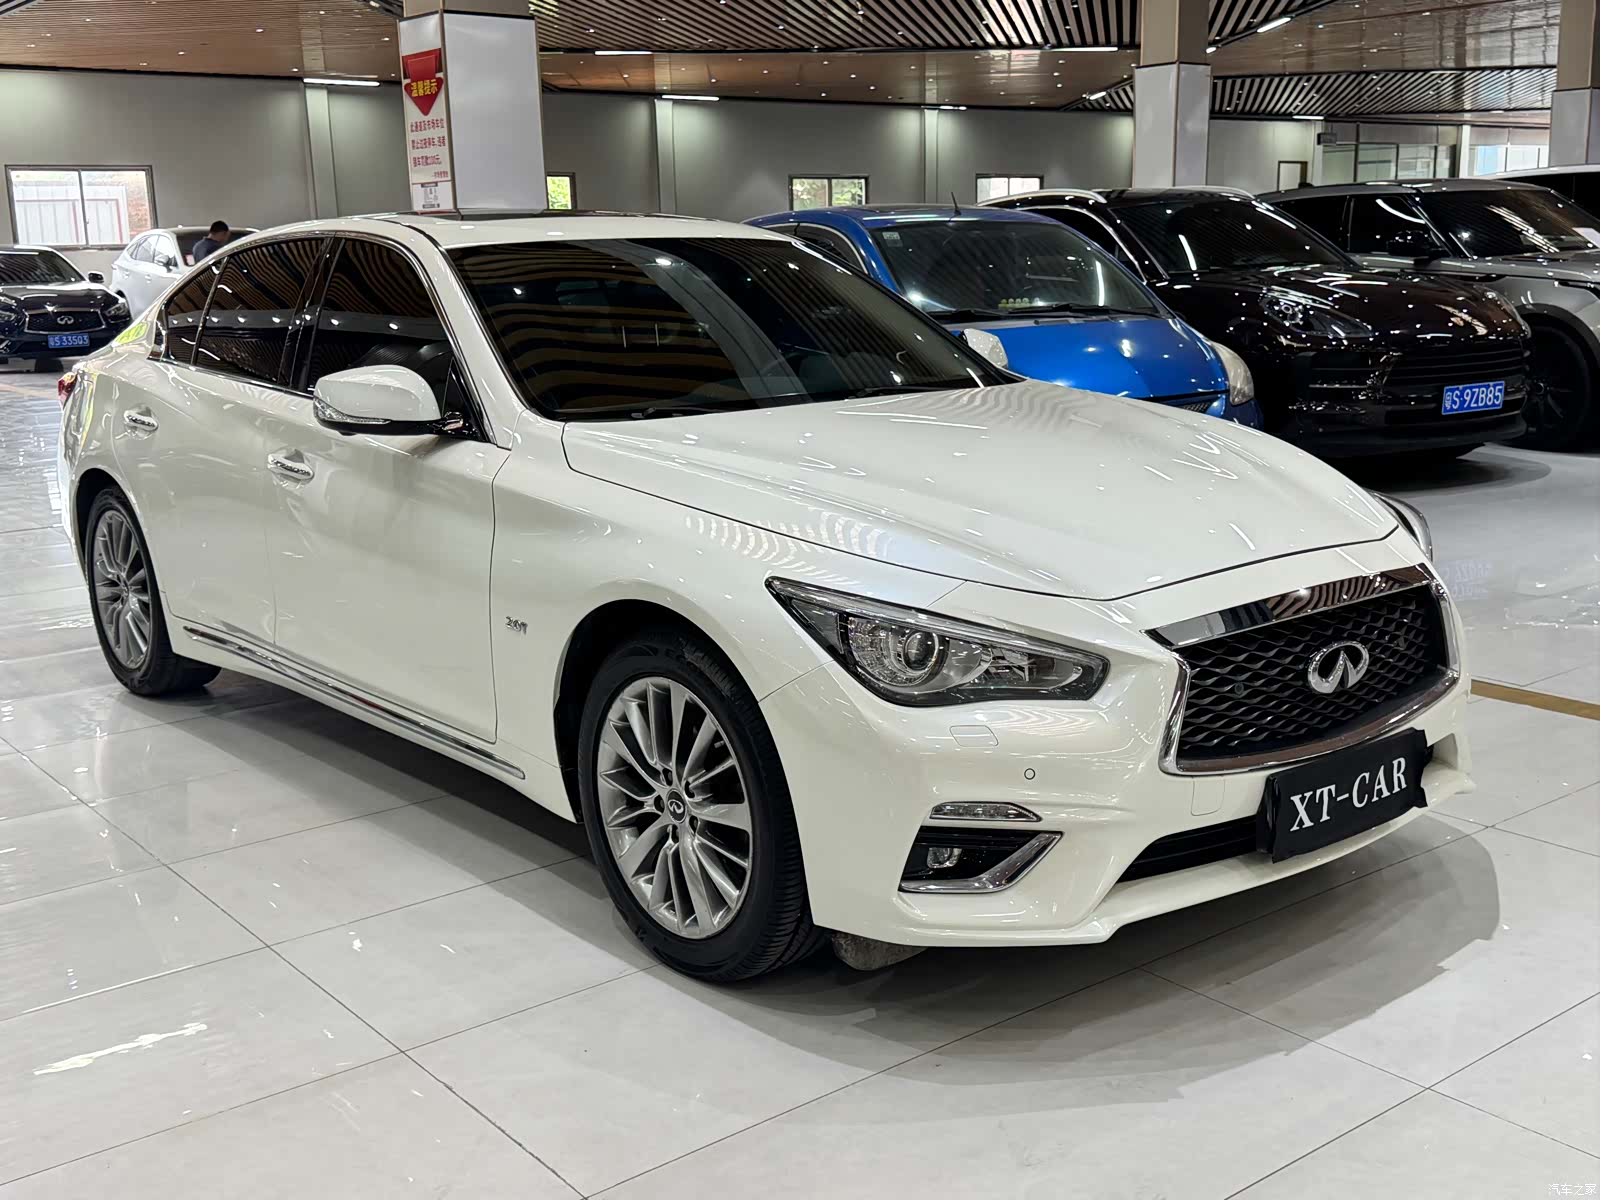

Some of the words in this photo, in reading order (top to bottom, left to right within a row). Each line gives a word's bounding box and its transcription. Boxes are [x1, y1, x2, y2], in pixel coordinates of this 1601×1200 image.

[411, 79, 438, 97] 温馨提示
[1289, 757, 1407, 832] XT-CAR
